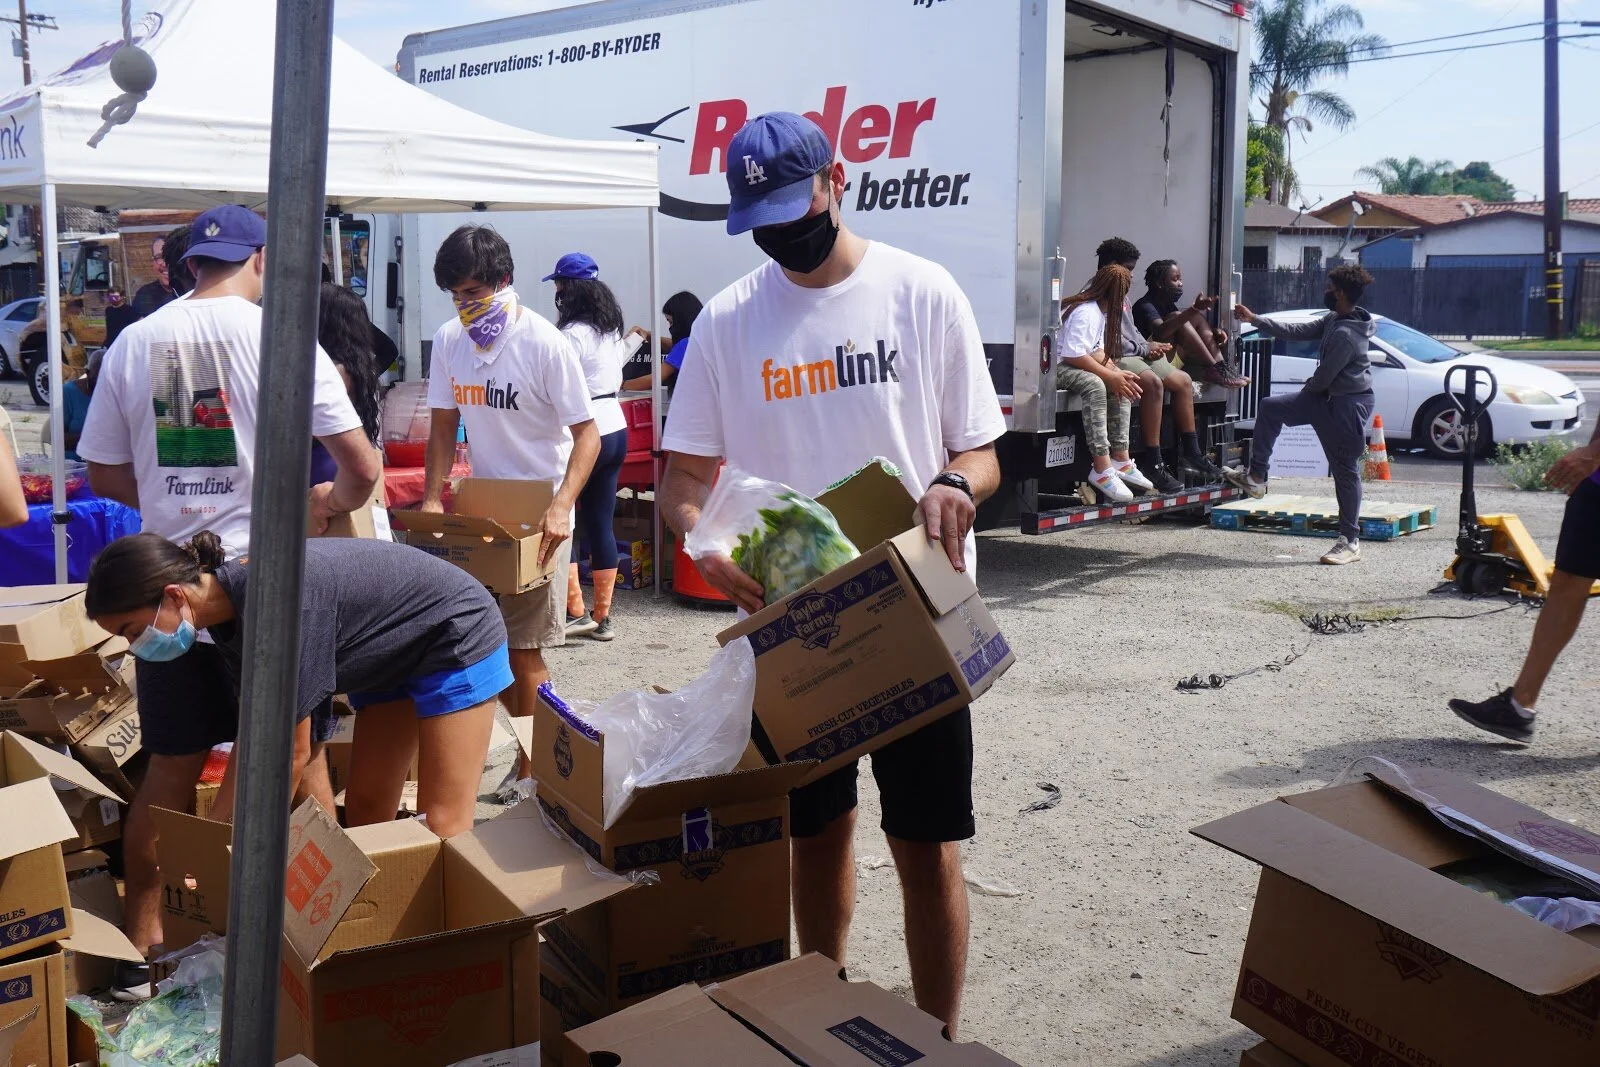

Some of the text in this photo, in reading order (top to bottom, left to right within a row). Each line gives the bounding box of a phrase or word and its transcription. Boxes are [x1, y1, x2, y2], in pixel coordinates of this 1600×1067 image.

[419, 32, 661, 84] Rental Reservations: 1-800-BY-RYDER
[689, 86, 936, 175] Rder
[742, 155, 768, 185] LA
[856, 168, 971, 212] better.
[761, 339, 900, 402] farmlink
[165, 475, 235, 496] Farmlink
[790, 596, 827, 623] Taylor
[795, 611, 835, 638] Farms
[807, 678, 915, 739] FRESH-CUT VEGETABLES
[105, 718, 141, 758] Silk
[1306, 988, 1382, 1042] FRESH-CUT
